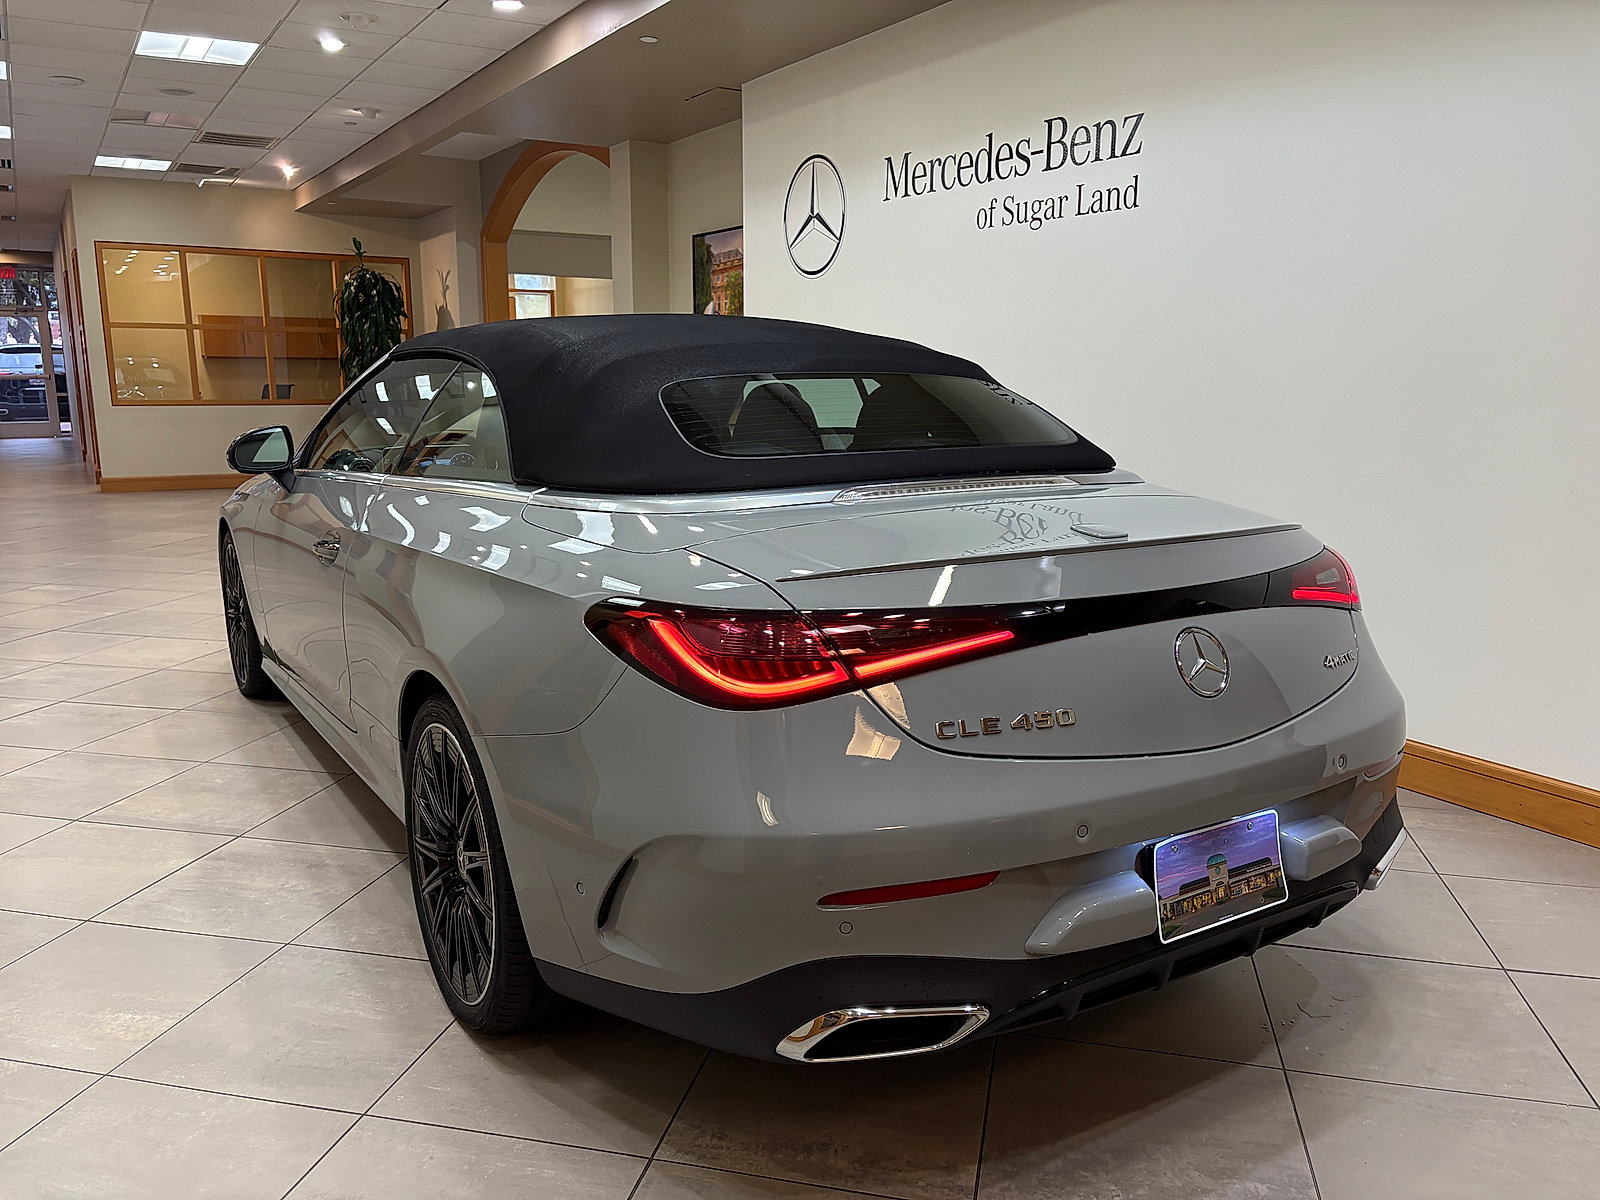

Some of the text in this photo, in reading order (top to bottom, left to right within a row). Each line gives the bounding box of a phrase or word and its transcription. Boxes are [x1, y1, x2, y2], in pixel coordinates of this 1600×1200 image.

[883, 112, 1145, 202] Mercedes-Benz
[976, 175, 1140, 231] of Sugar Land
[935, 707, 1077, 739] CLE 450
